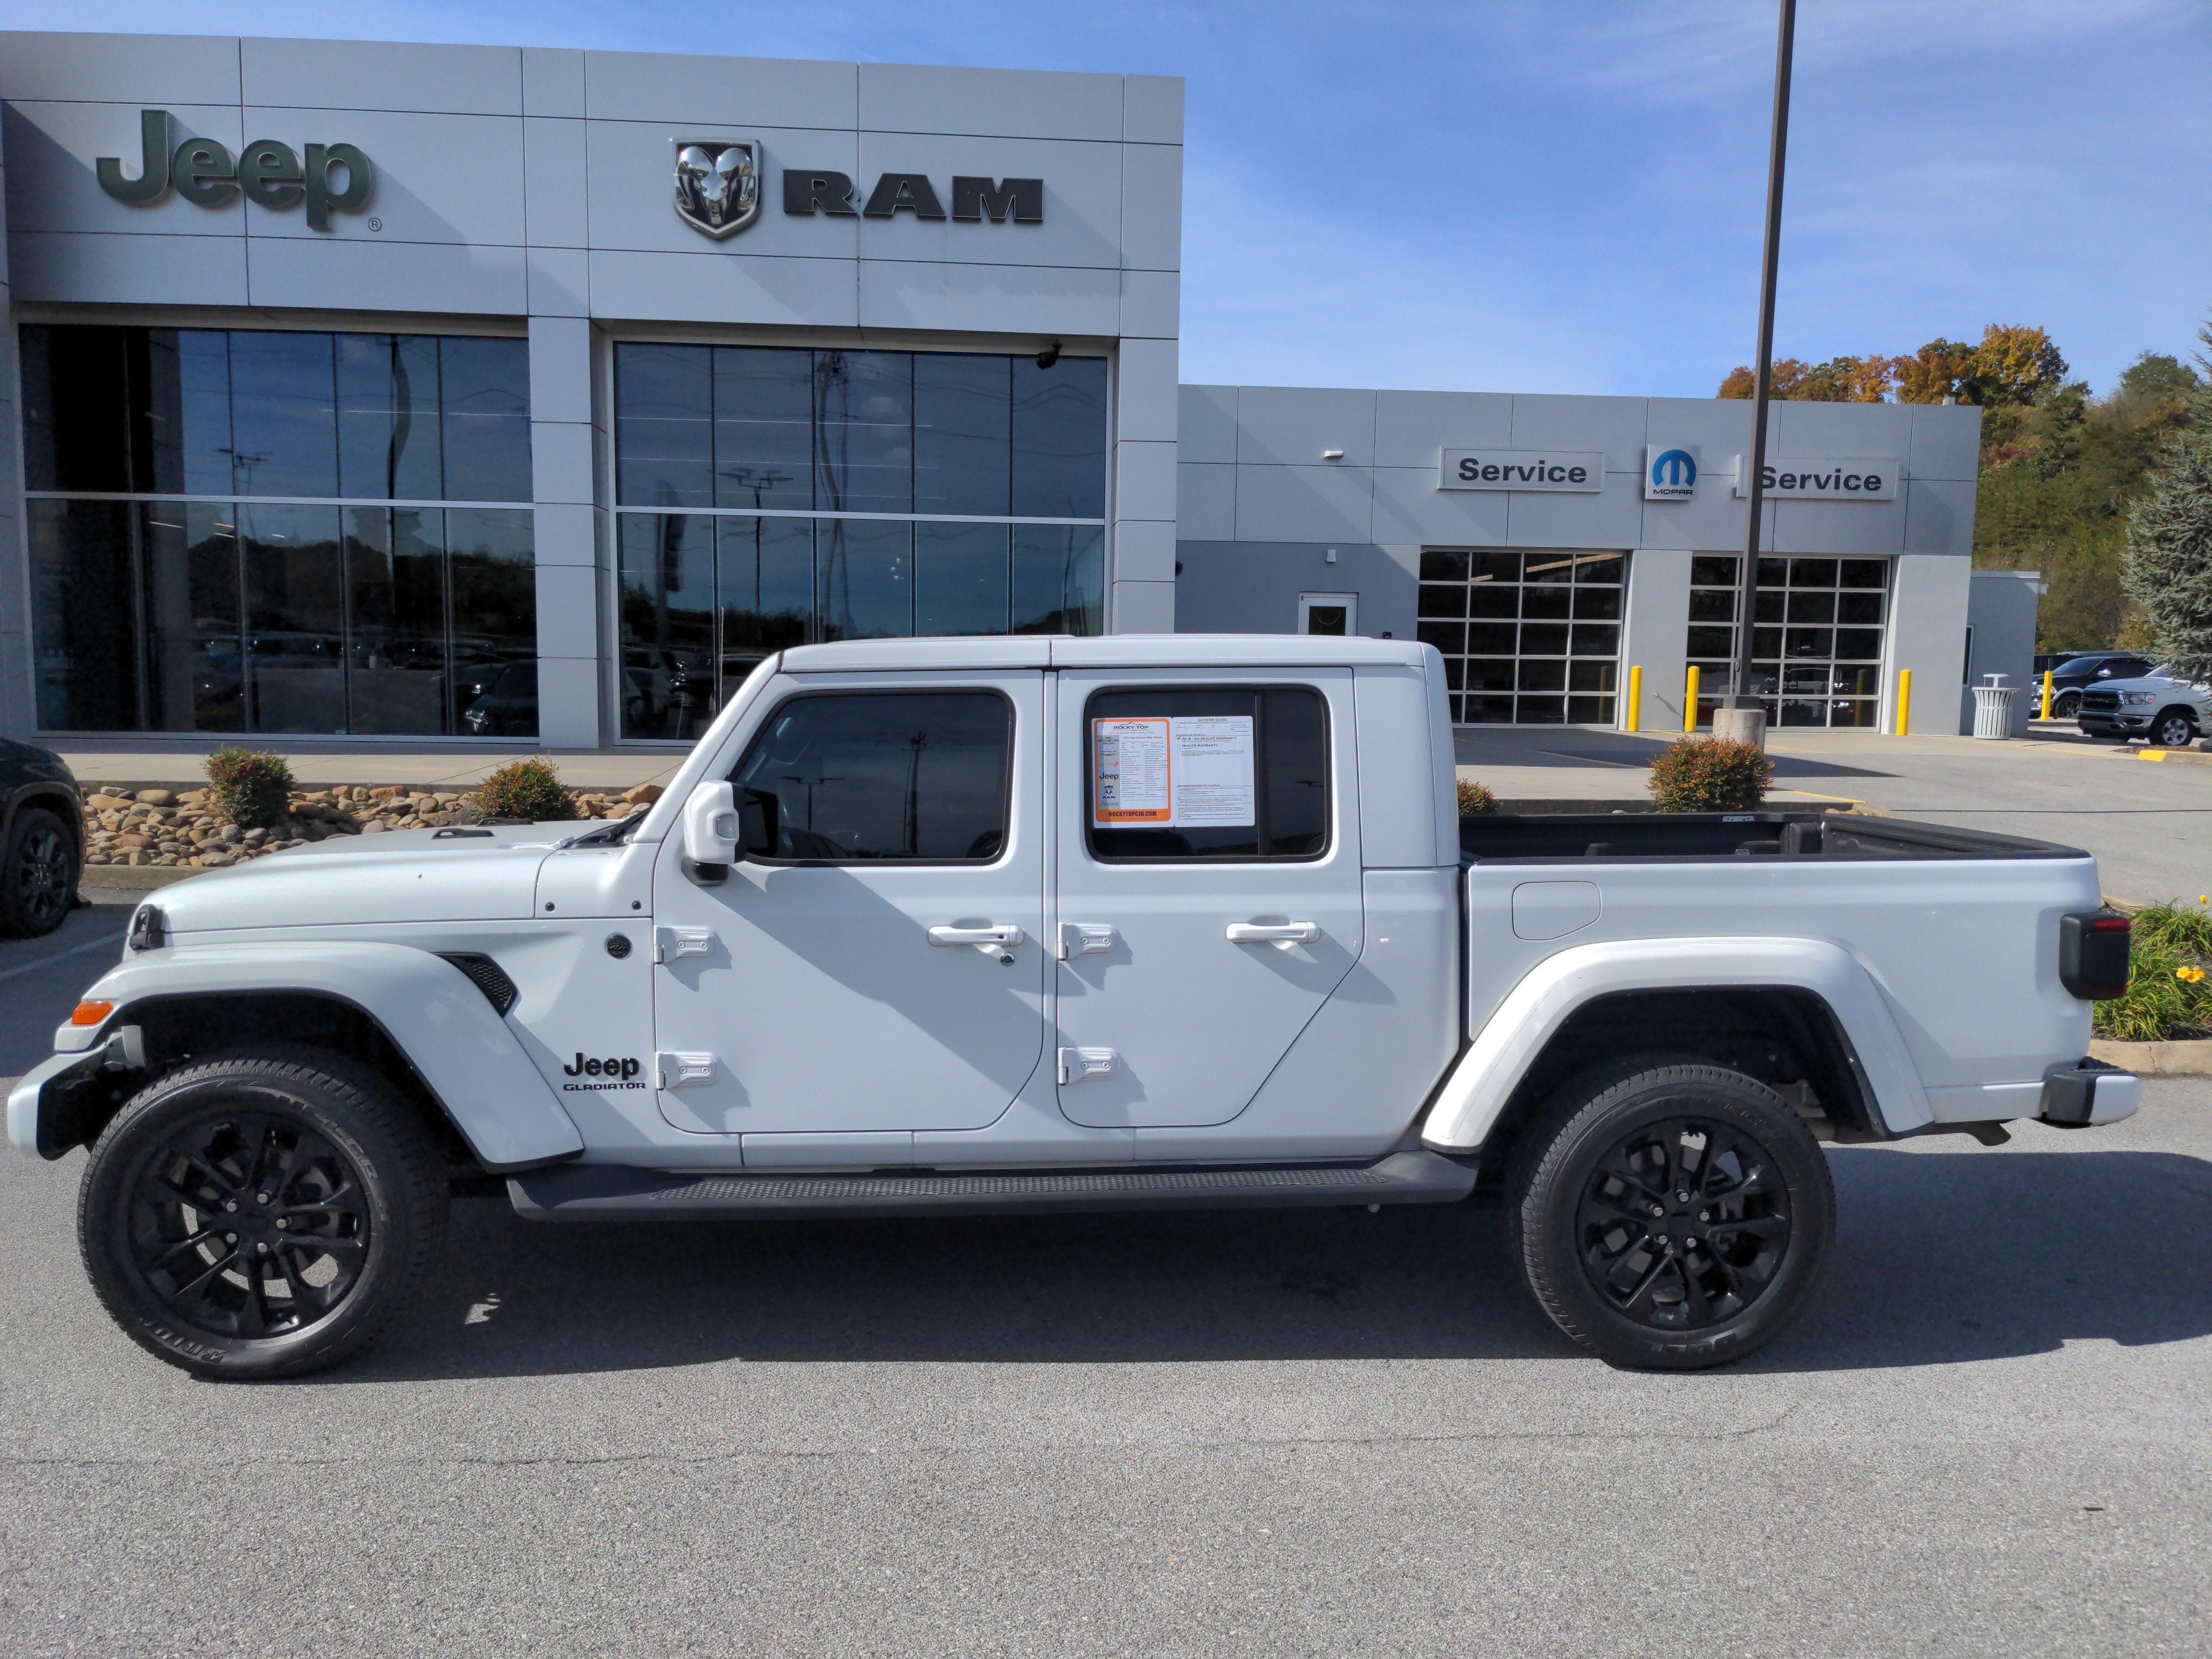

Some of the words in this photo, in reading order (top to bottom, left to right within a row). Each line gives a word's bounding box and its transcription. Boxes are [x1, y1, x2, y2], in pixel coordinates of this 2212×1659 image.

[95, 109, 371, 232] Jeep
[782, 168, 1044, 221] RAM
[1458, 458, 1587, 483] Service
[1762, 466, 1882, 491] Service
[563, 1052, 640, 1081] Jeep
[563, 1082, 646, 1091] GLADIATOR
